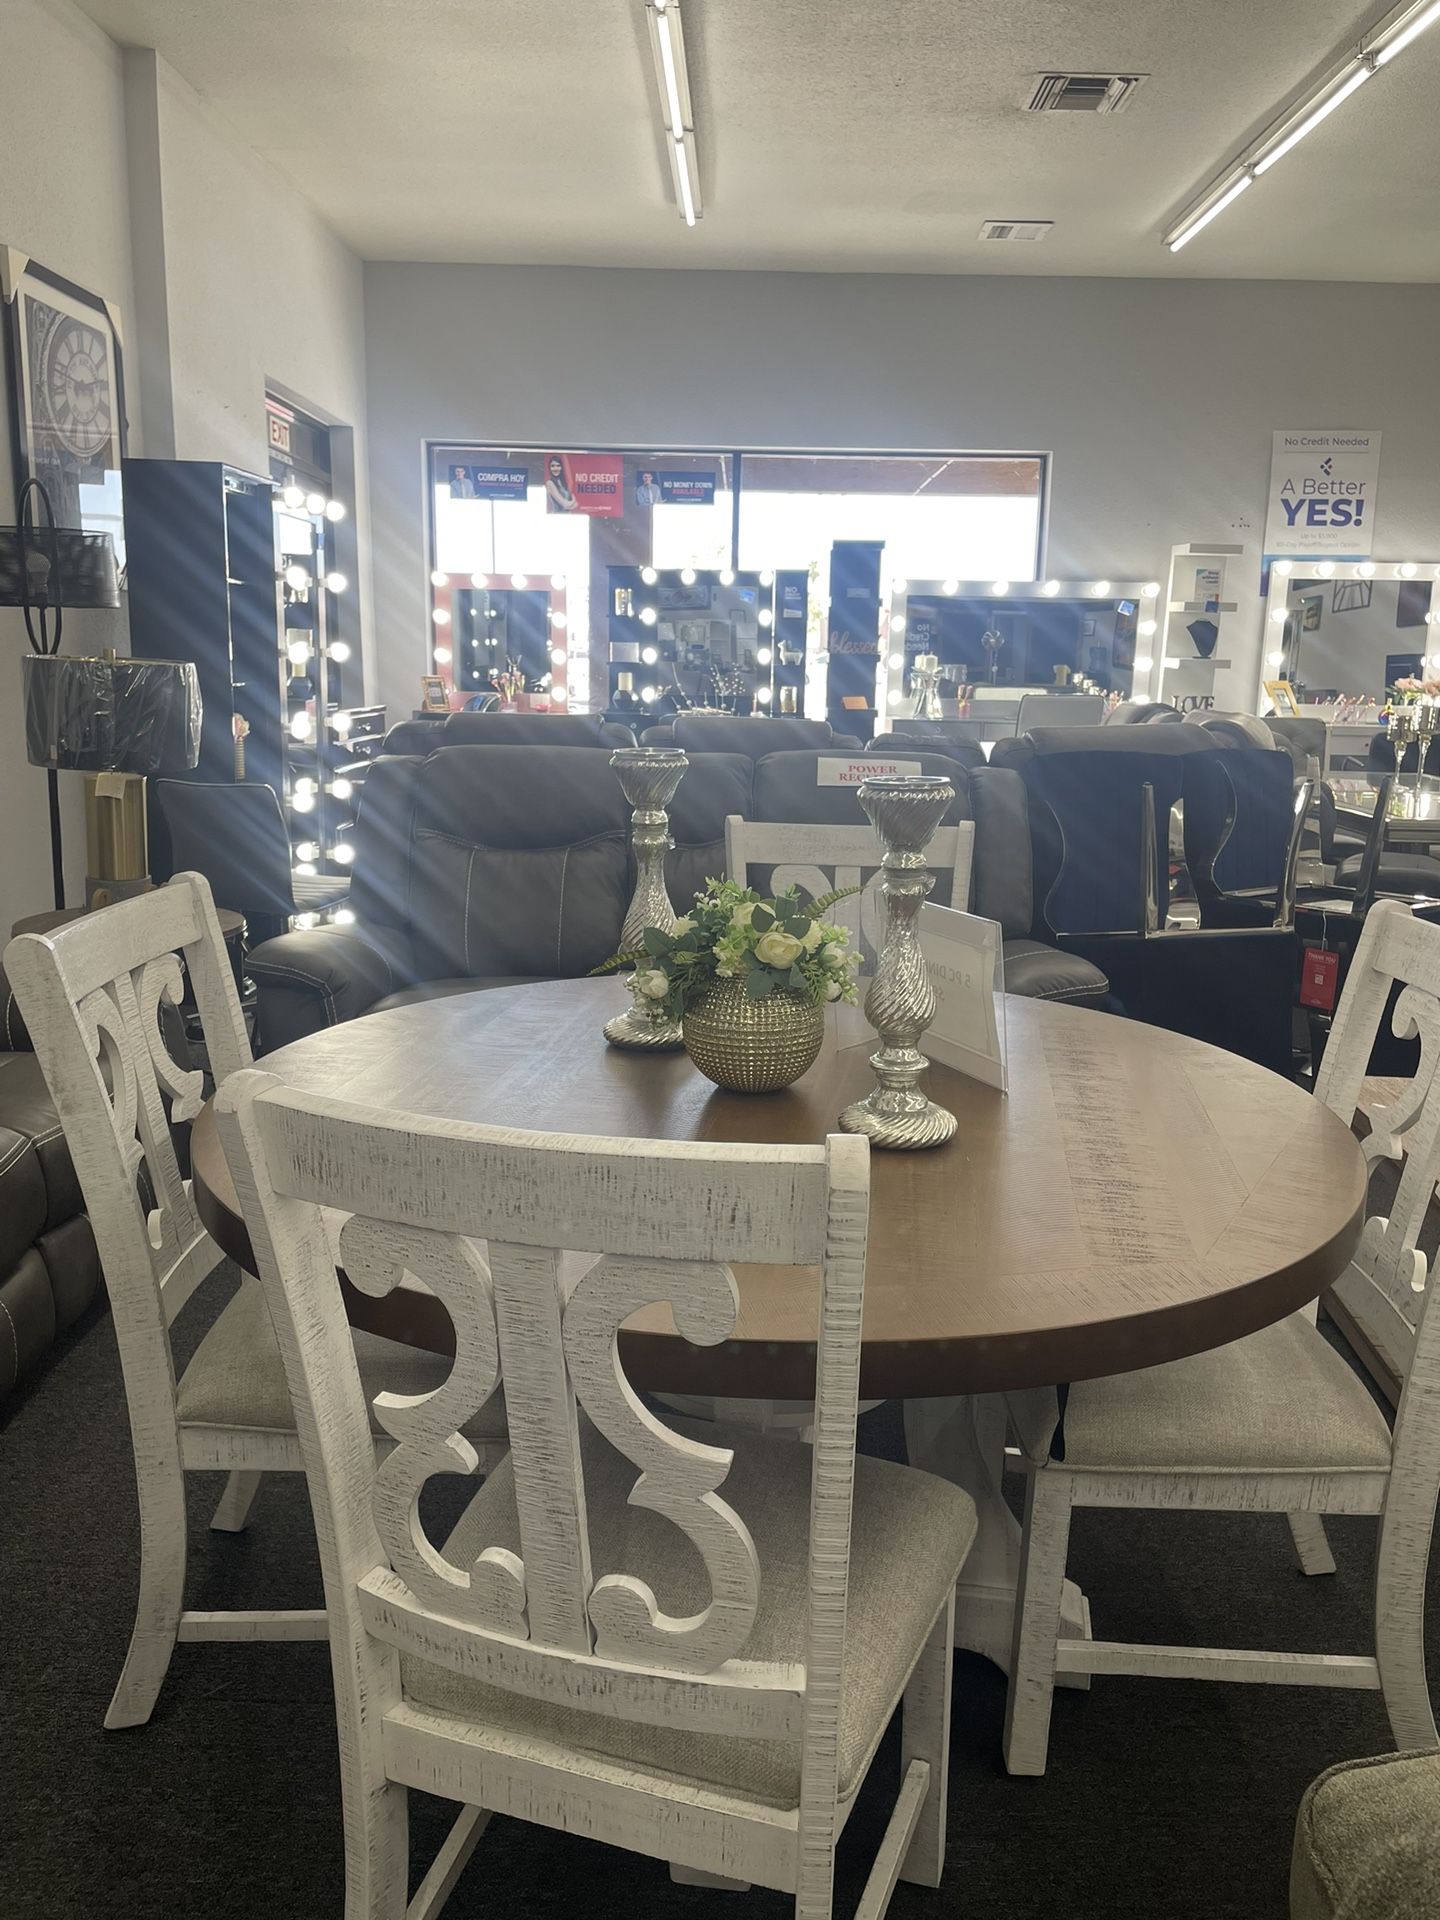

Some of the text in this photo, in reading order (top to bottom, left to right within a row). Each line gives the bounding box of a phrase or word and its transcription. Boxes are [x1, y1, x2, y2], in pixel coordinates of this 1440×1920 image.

[272, 420, 289, 447] EXIT
[1284, 437, 1370, 446] No Credit Needed
[477, 472, 526, 483] COMPRA HOY
[575, 473, 620, 483] NO CREDIT
[577, 483, 617, 494] NEEDED
[663, 481, 673, 489] NO
[673, 481, 694, 489] MONEY
[1280, 478, 1367, 495] A Better
[1280, 498, 1365, 527] YES!
[848, 765, 897, 774] POWER
